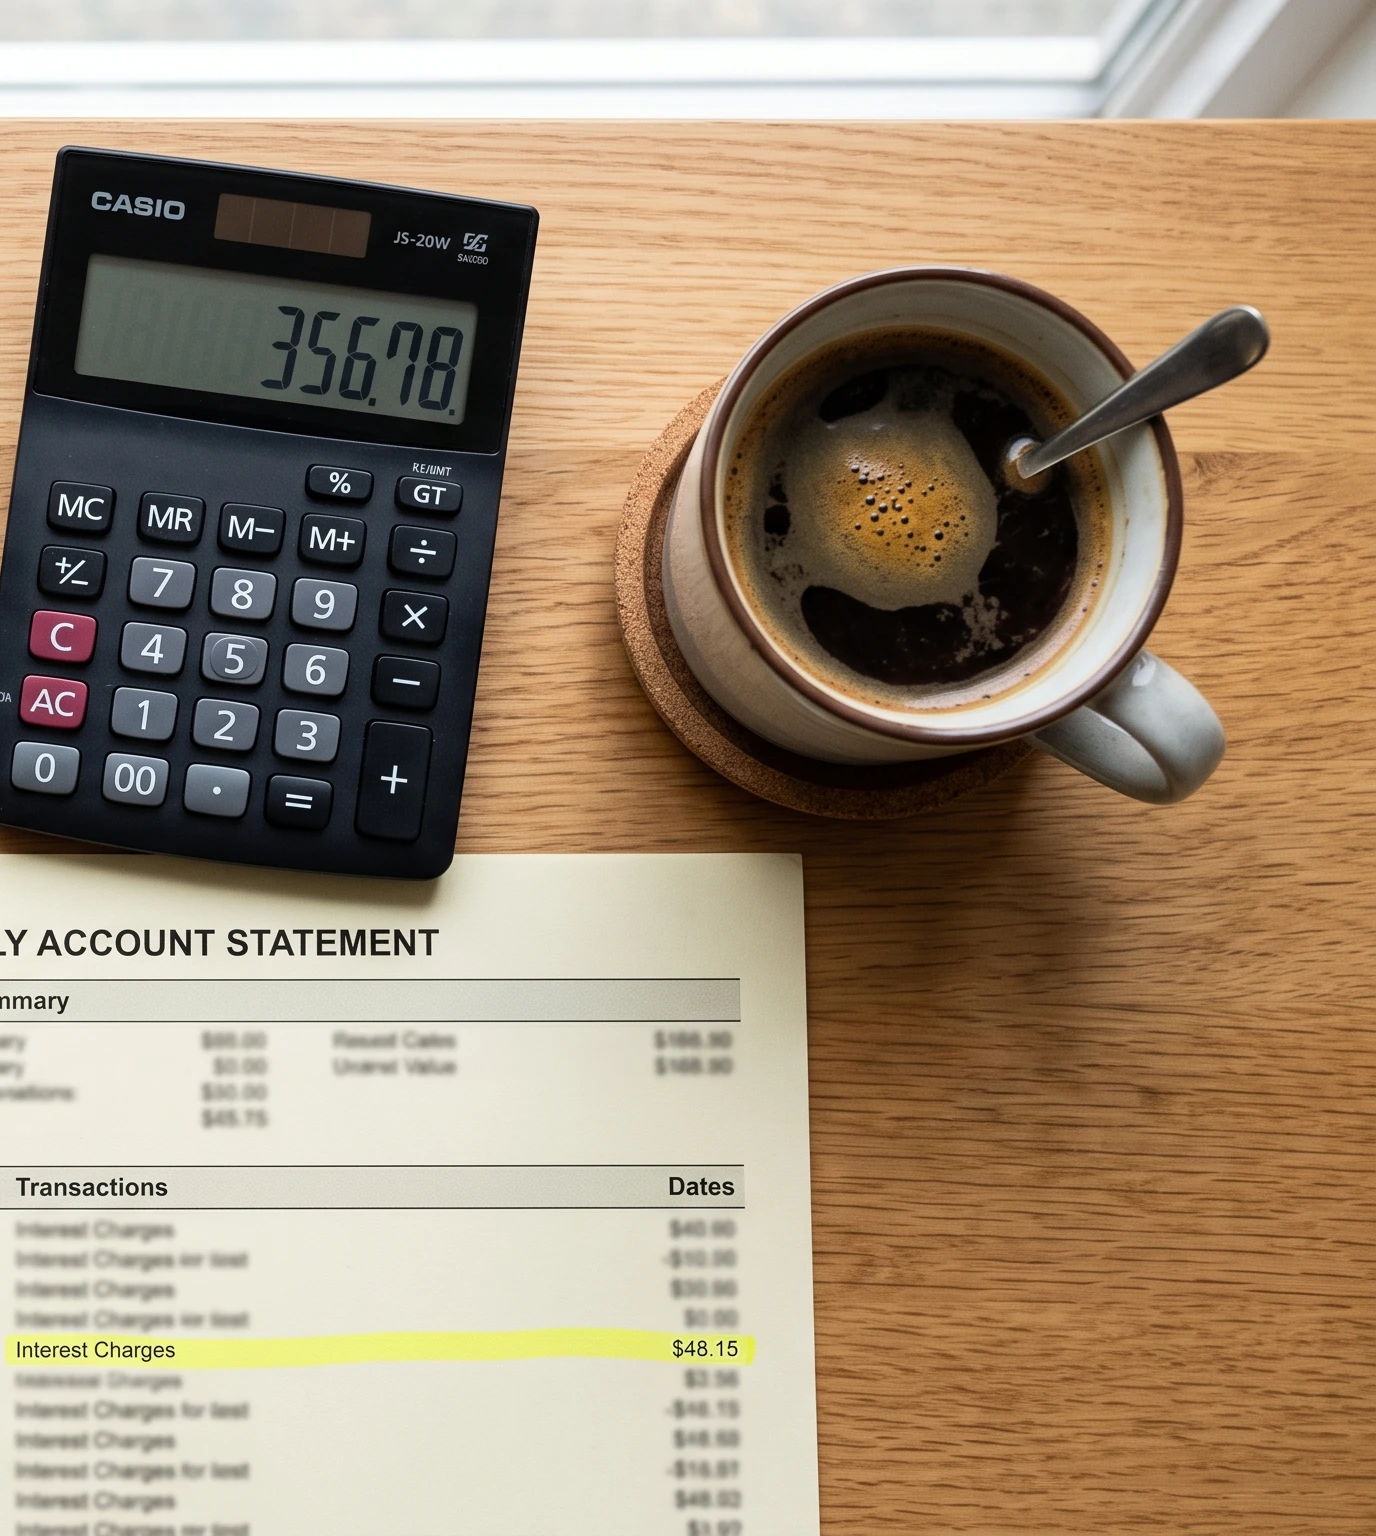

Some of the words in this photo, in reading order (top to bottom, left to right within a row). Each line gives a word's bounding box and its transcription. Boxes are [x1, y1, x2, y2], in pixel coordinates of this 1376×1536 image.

[92, 192, 185, 220] CASIO
[394, 232, 451, 249] JS-20W
[330, 470, 354, 493] %
[413, 484, 447, 505] GT
[58, 494, 104, 520] MC
[148, 505, 192, 531] MR
[310, 526, 355, 551] M+
[153, 568, 173, 597] 7
[232, 579, 253, 609] 8
[314, 590, 334, 619] 9
[51, 623, 74, 651] C
[141, 634, 163, 664] 4
[224, 644, 246, 675] 5
[306, 655, 326, 684] 6
[30, 689, 75, 716] AC
[139, 700, 149, 730] 1
[214, 710, 235, 741] 2
[297, 721, 317, 750] 3
[35, 753, 55, 782] 0
[115, 764, 156, 796] 00
[37, 929, 215, 956] ACCOUNT
[227, 929, 439, 956] STATEMENT
[16, 1178, 167, 1196] Transactions
[670, 1177, 734, 1195] Dates
[18, 1342, 87, 1358] Interest
[95, 1341, 175, 1362] Charges
[673, 1340, 737, 1358] $48.15
